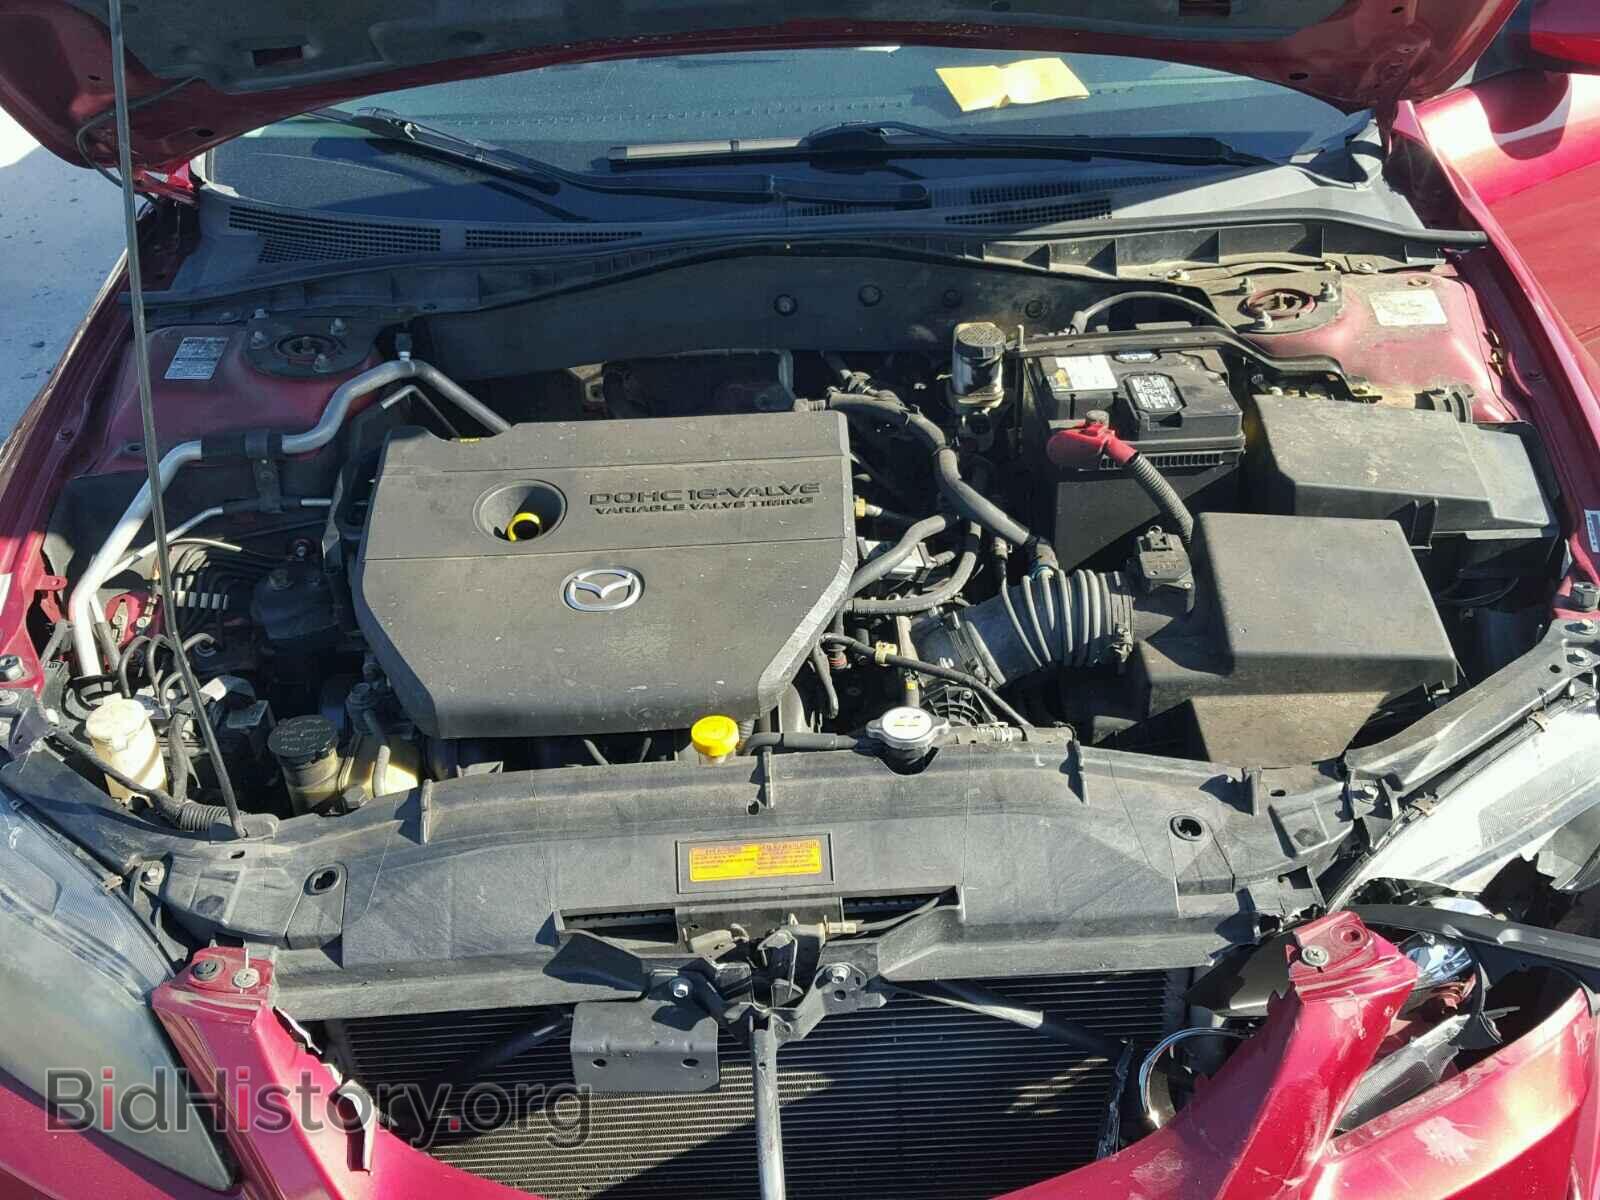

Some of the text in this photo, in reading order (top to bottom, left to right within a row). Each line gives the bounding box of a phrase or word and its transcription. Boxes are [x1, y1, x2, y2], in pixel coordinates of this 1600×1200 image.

[589, 482, 821, 505] DOHC 16-VALVE
[595, 496, 814, 514] VARIABLE VALVE TIMING
